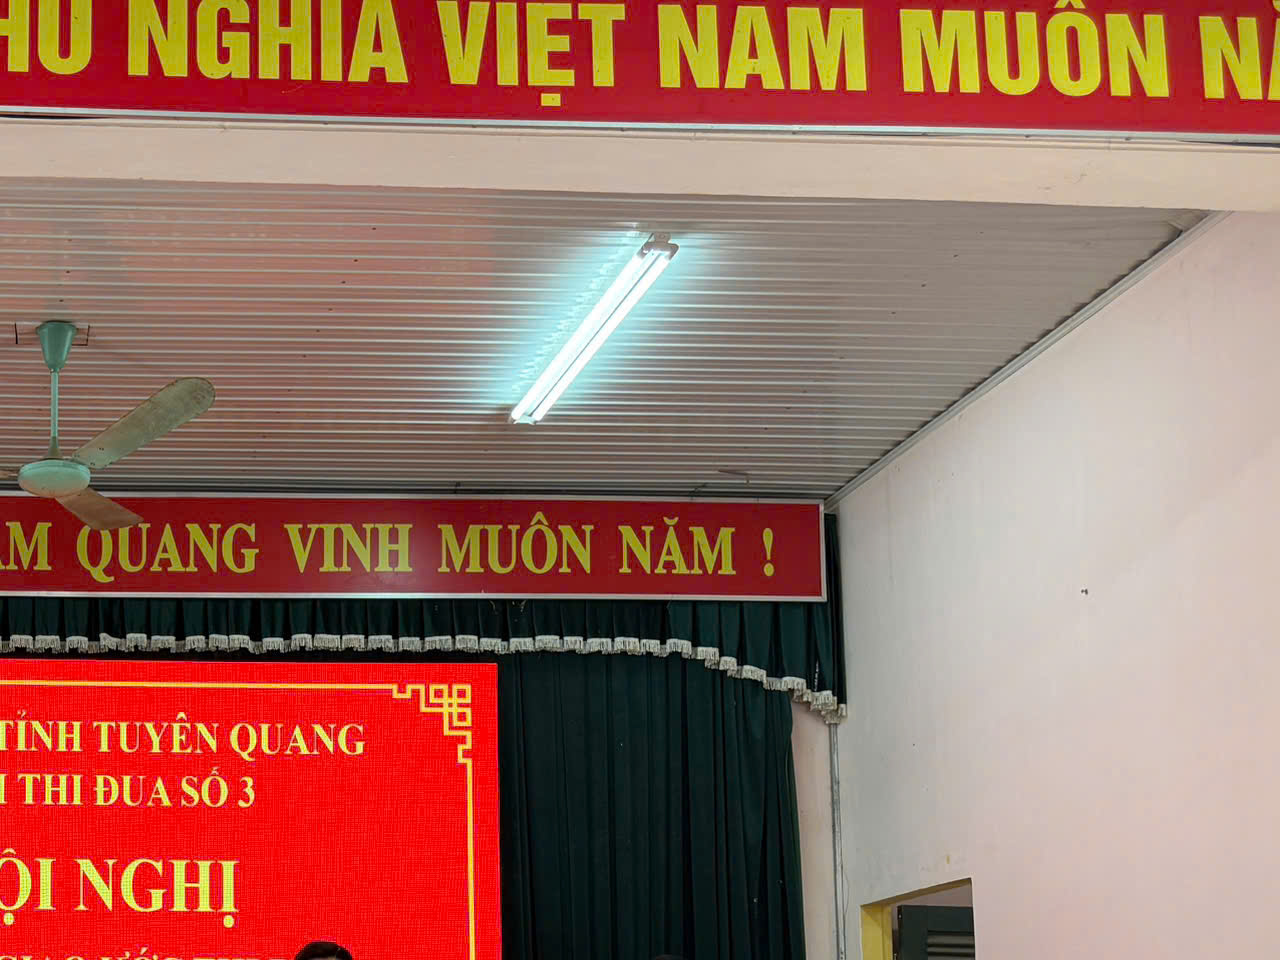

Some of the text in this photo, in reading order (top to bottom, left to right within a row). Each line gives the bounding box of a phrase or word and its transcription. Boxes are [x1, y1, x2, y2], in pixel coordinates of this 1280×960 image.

[658, 4, 868, 92] NAM
[900, 0, 1170, 98] MUÔN
[76, 522, 260, 583] QUANG
[284, 523, 415, 574] VINH
[438, 511, 595, 575] MUÔN
[619, 516, 737, 577] NĂM
[93, 711, 219, 754] TUYÊN
[229, 723, 366, 762] QUANG
[17, 773, 83, 806] THI
[93, 775, 172, 807] ĐUA
[181, 767, 229, 808] SỐ
[237, 776, 256, 808] 3
[75, 858, 239, 929] NGHỊ
